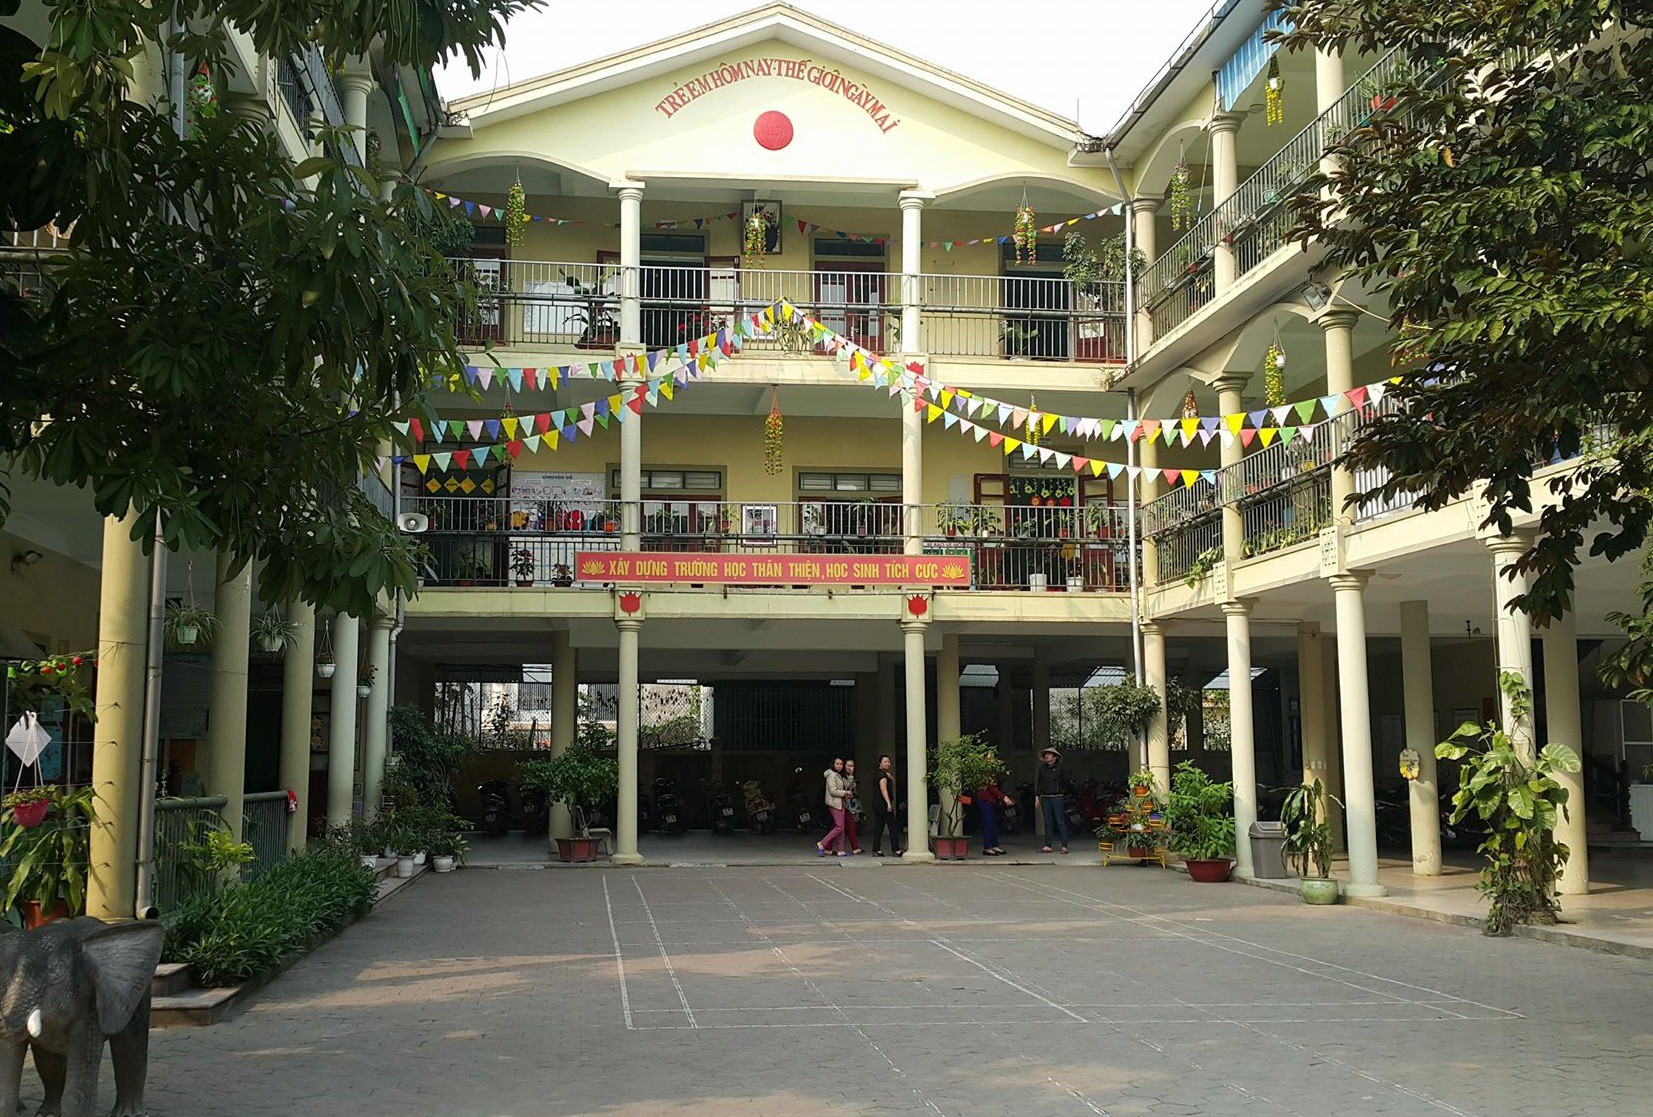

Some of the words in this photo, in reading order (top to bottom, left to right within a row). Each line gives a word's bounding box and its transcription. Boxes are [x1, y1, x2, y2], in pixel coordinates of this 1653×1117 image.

[684, 74, 713, 100] EM
[708, 62, 746, 88] HÔM
[743, 58, 774, 78] NAY
[776, 59, 812, 80] THẾ
[835, 83, 876, 110] NGÀY
[866, 100, 901, 134] MAI
[609, 558, 630, 576] XÂY
[636, 559, 668, 579] DỰNG
[674, 558, 718, 577] TRƯỜNG
[724, 562, 746, 580] HỌC
[752, 559, 782, 577] THÂN
[826, 562, 848, 581] HỌC
[853, 563, 879, 578] SINH
[885, 560, 909, 578] TÍCH
[915, 562, 938, 581] CỰC
